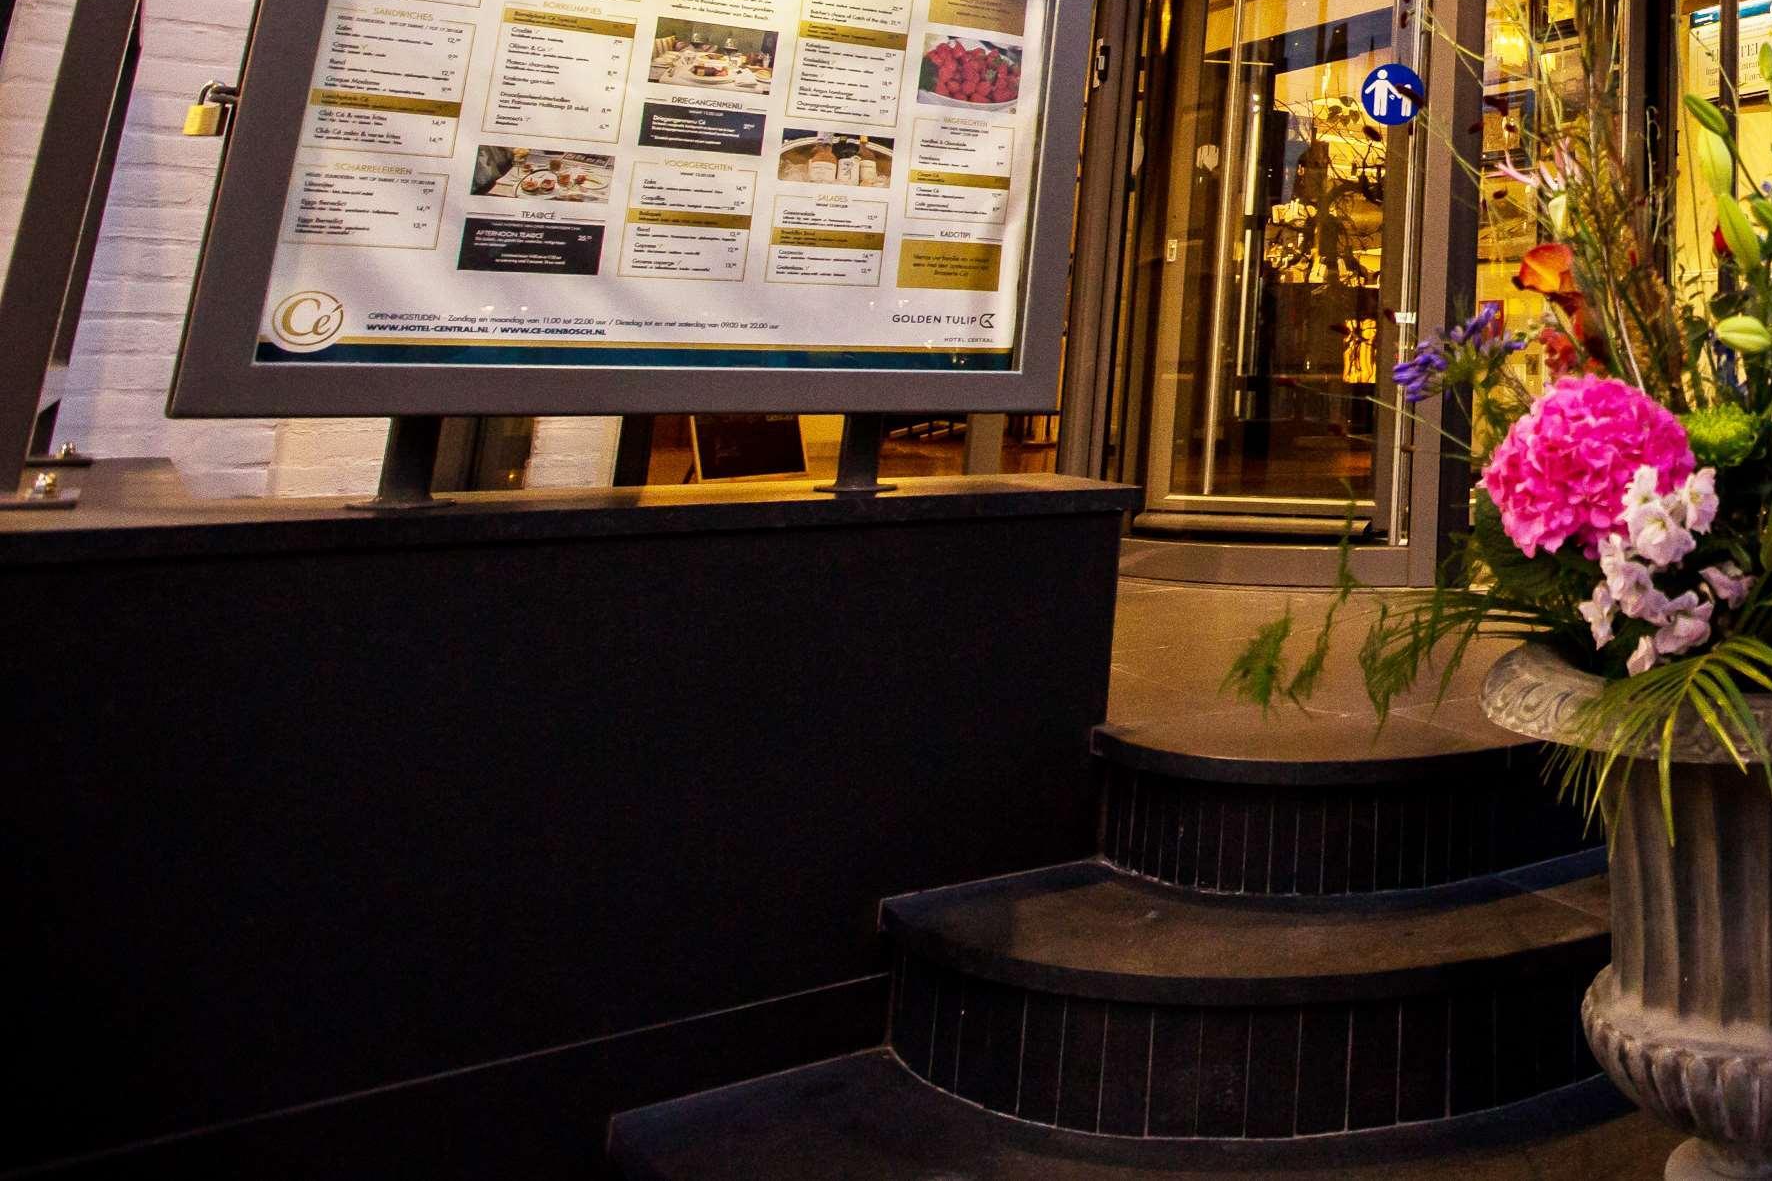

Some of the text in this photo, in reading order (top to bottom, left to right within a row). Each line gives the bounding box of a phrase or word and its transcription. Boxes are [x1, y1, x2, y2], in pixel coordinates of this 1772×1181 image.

[372, 6, 434, 22] SANDWICHES
[671, 96, 743, 110] DRIEGANGENMENU
[447, 314, 476, 322] Zondag
[892, 313, 976, 324] GOLDEN TULIP
[365, 323, 489, 333] WWW.HOTEL-CENTRAL.NL
[499, 326, 607, 336] WWW.CE-DENBOSCH.NL
